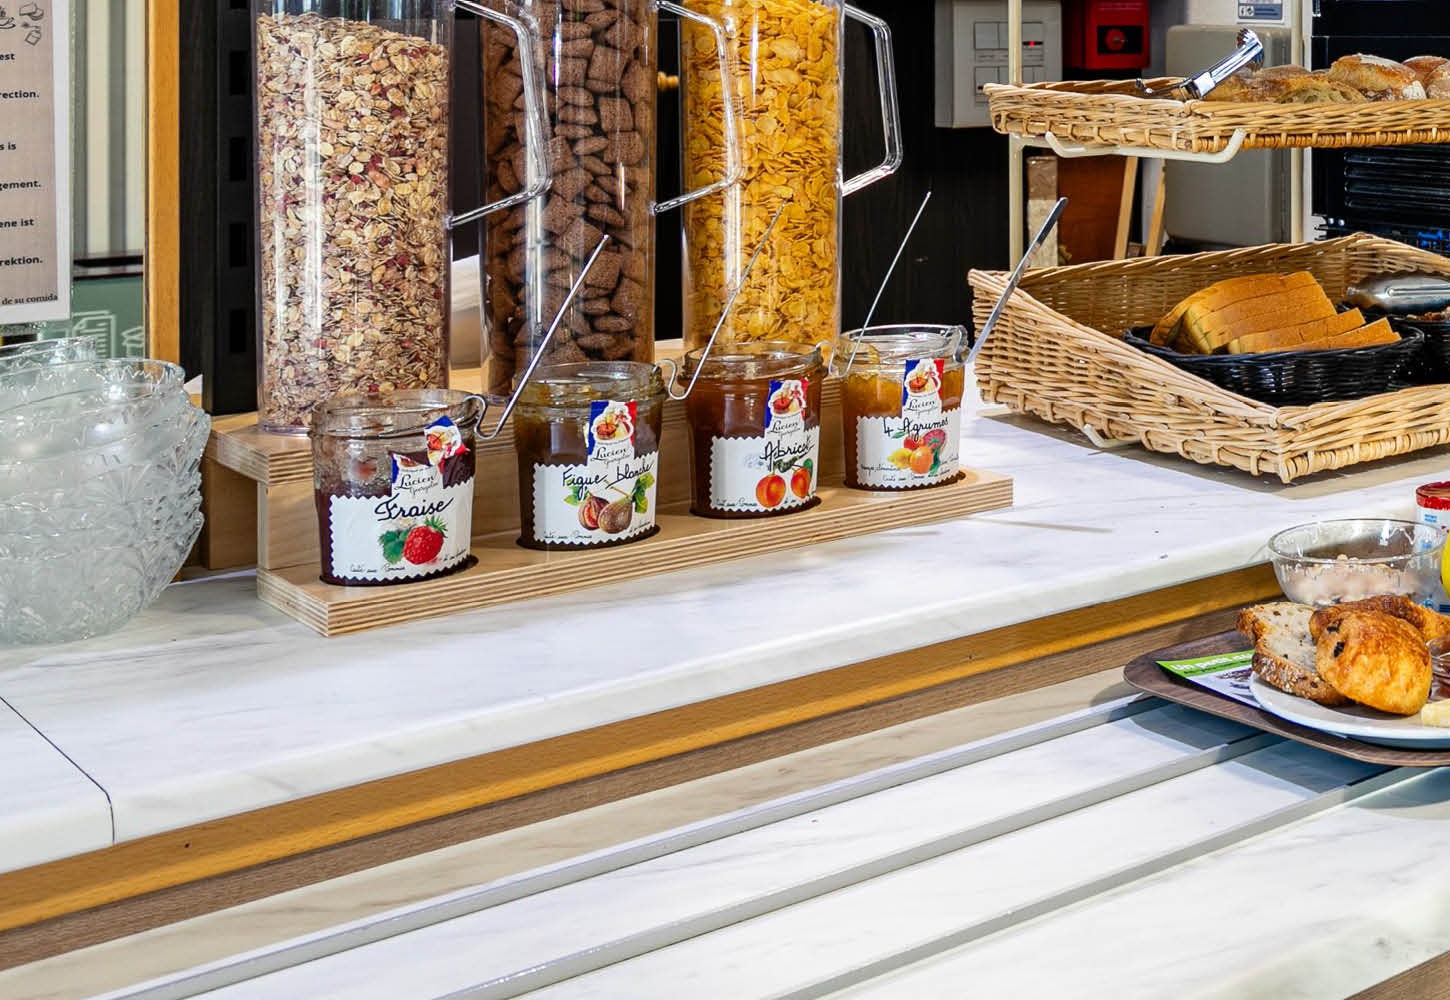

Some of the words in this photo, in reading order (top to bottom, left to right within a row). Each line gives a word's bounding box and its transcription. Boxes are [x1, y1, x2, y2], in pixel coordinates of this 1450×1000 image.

[21, 217, 34, 228] ist
[898, 416, 949, 443] Agrumes
[591, 446, 628, 461] Lucien
[394, 474, 434, 490] Lucien
[562, 467, 608, 501] Figue
[605, 459, 654, 490] blanche
[375, 493, 454, 521] Fraise
